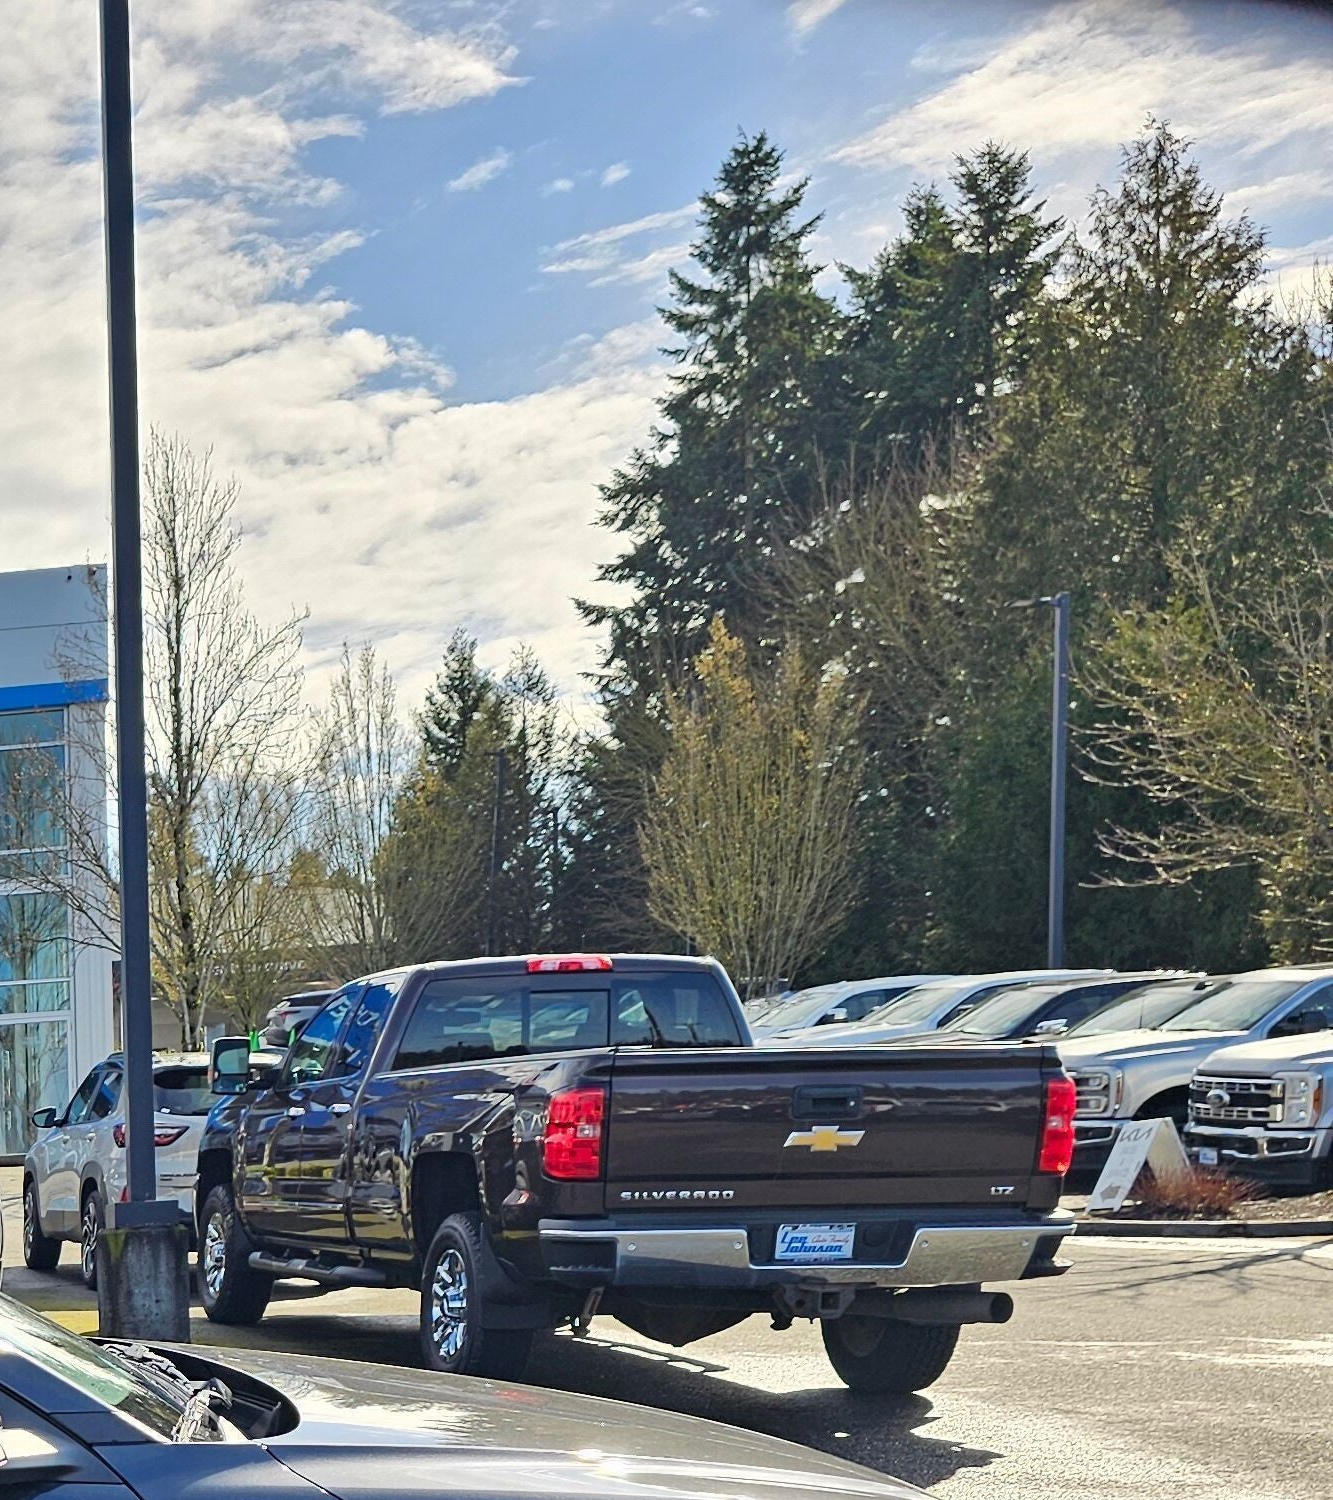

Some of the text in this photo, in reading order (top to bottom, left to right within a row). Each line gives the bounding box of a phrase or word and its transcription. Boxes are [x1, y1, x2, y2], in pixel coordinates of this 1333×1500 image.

[620, 1190, 735, 1200] SILVERADO
[990, 1186, 1015, 1196] LTZ
[780, 1231, 809, 1243] Lee
[780, 1242, 844, 1253] Johnson
